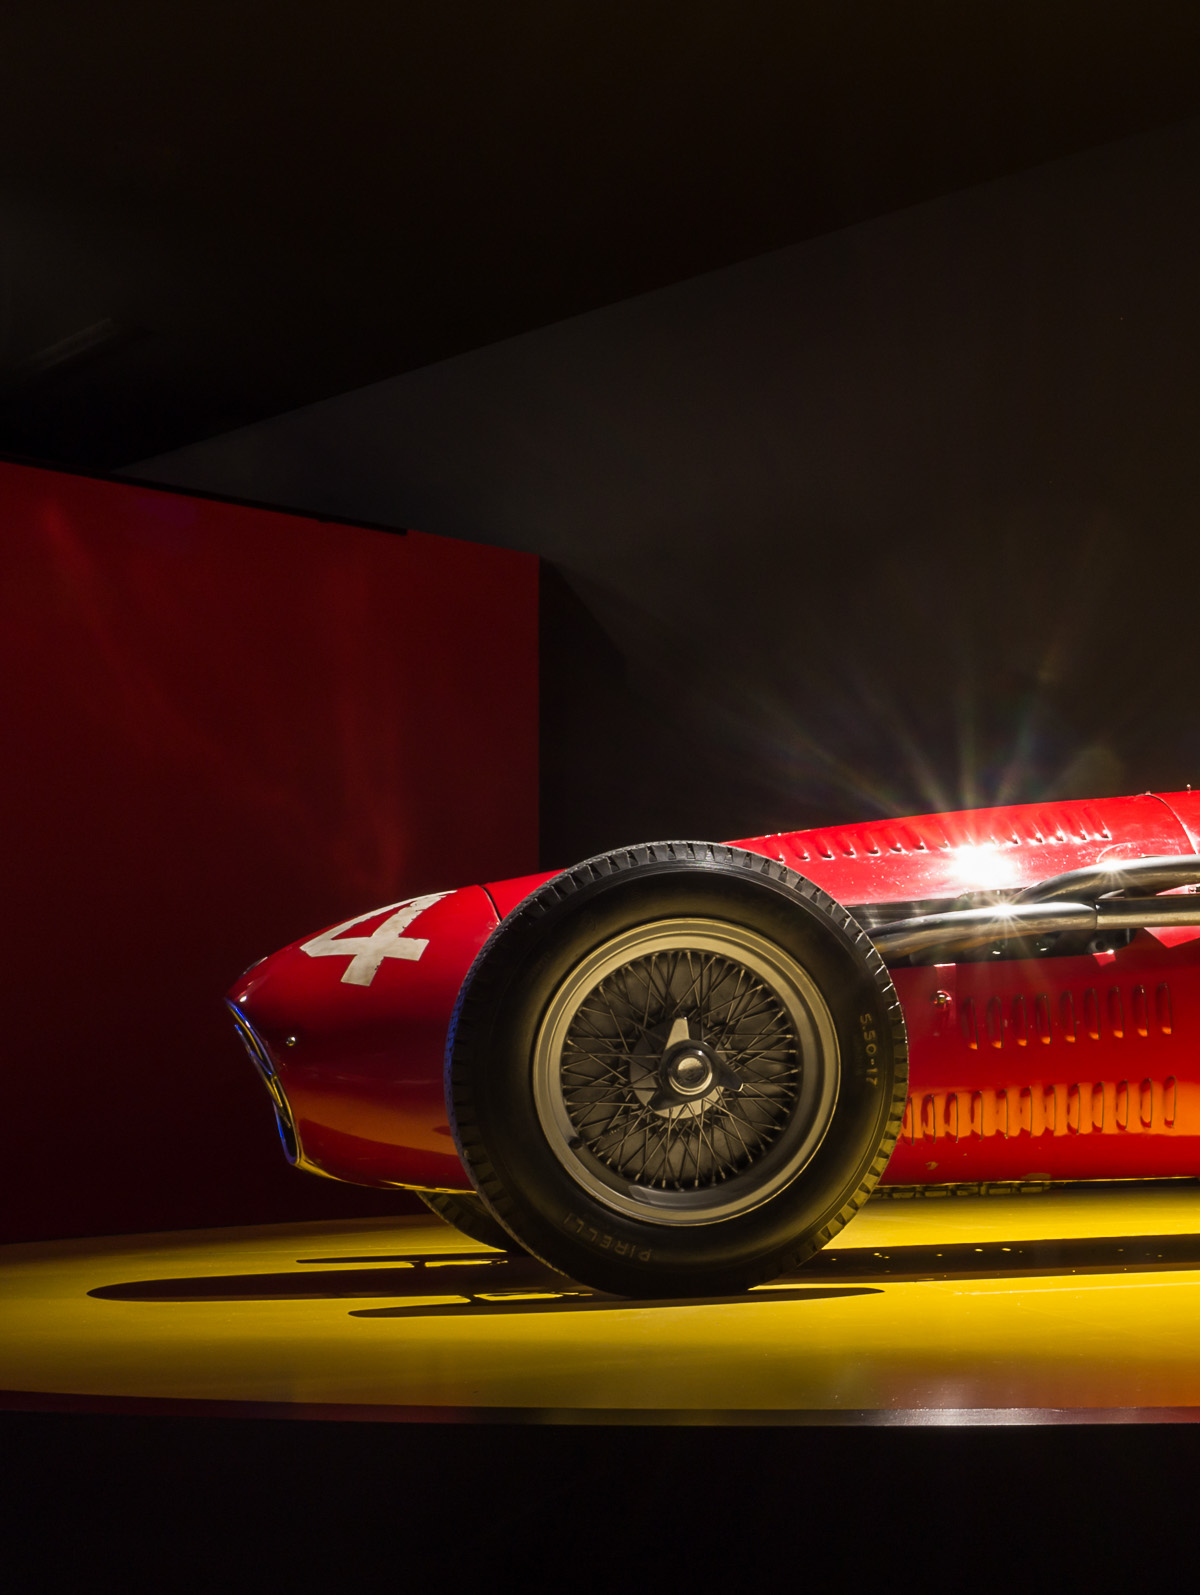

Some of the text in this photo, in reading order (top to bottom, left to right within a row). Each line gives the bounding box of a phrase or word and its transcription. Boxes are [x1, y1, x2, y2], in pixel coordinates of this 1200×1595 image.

[299, 889, 458, 987] 4
[860, 1012, 879, 1088] 5.50-17
[563, 1212, 655, 1262] PIRELLI
